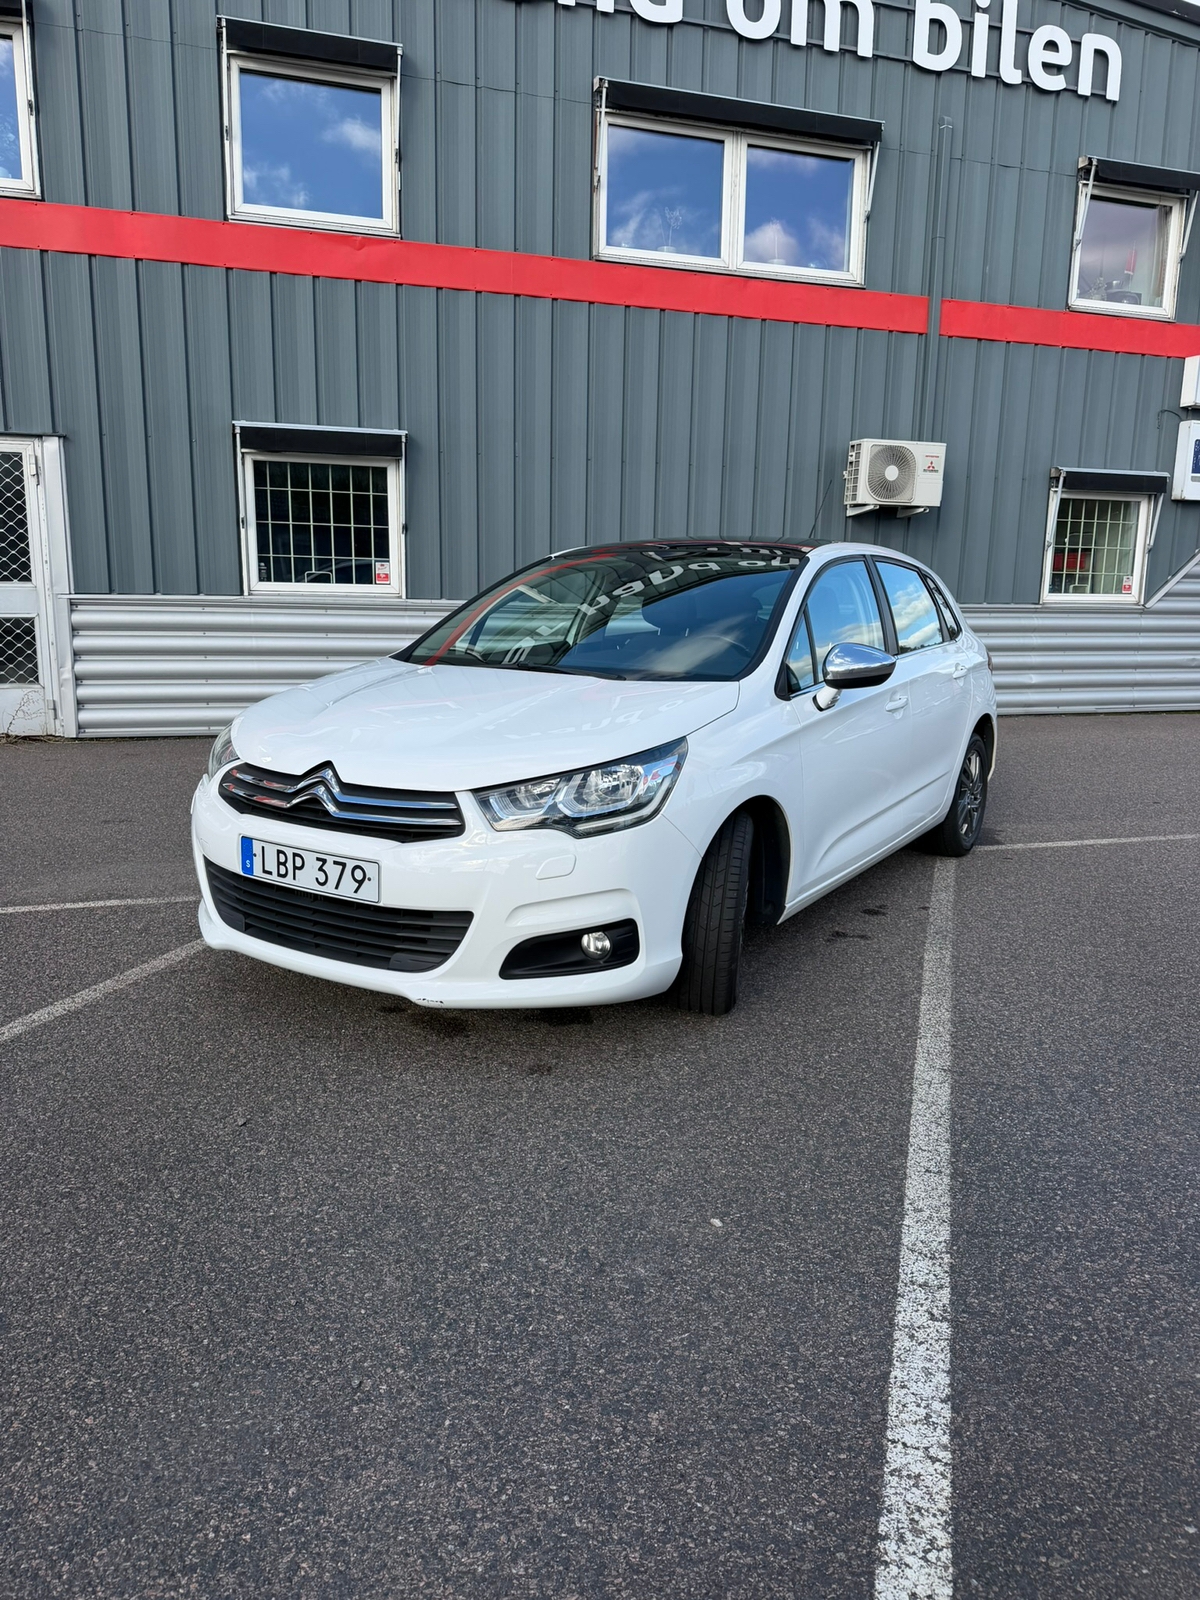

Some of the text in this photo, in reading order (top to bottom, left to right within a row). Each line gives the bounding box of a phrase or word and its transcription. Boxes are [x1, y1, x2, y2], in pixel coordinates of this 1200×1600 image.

[726, 0, 1123, 102] om bilen
[245, 859, 251, 868] S
[261, 845, 367, 894] LBP 379
